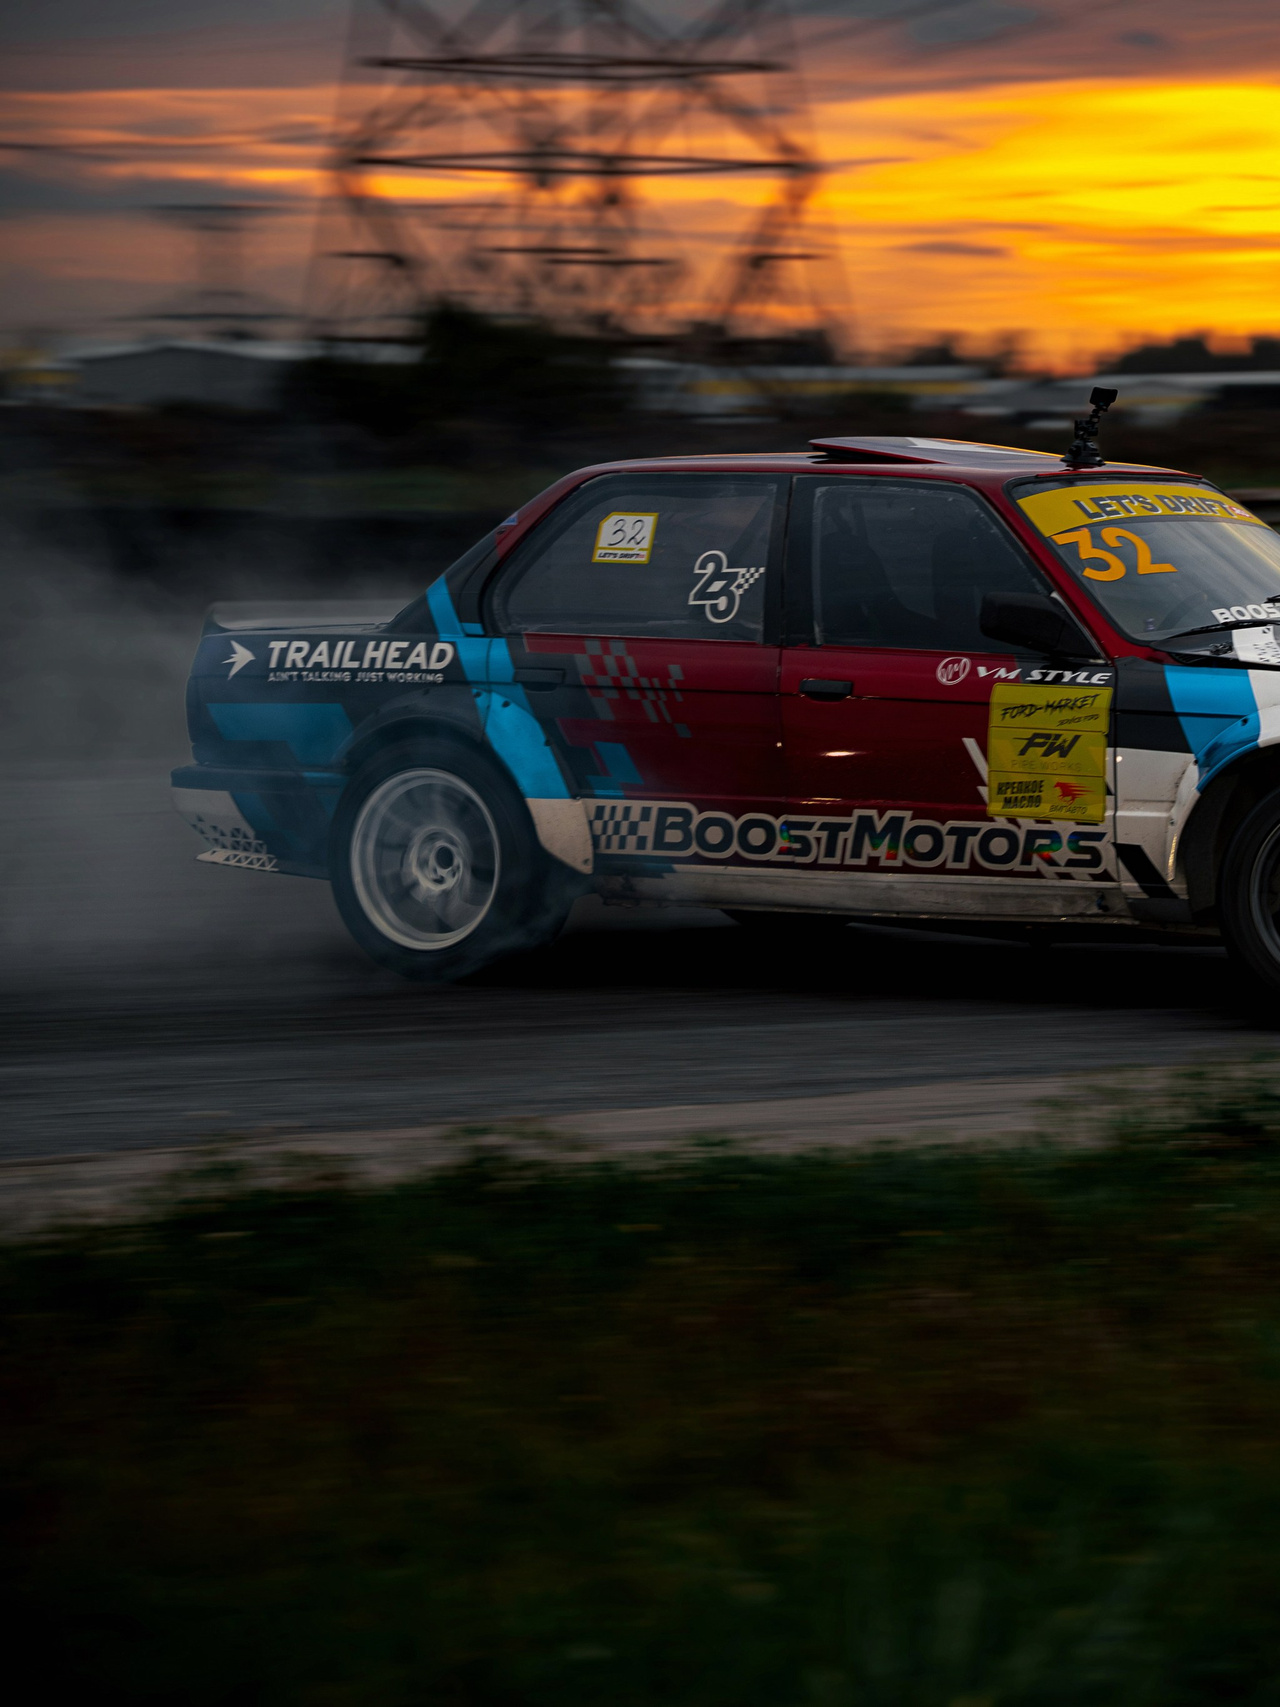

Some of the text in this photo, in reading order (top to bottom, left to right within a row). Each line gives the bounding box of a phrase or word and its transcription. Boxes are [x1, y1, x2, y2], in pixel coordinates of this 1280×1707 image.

[1072, 494, 1162, 521] LET'S
[1154, 494, 1237, 519] DRIFT
[607, 518, 647, 547] 32
[1051, 526, 1179, 583] 32
[267, 640, 455, 670] TRAILHEAD
[267, 671, 445, 685] AIN'T TALKING JUST WORKING
[976, 666, 1113, 685] VM STYLE
[996, 780, 1045, 796] КРЕПКОЕ
[1001, 795, 1043, 810] МАСЛО
